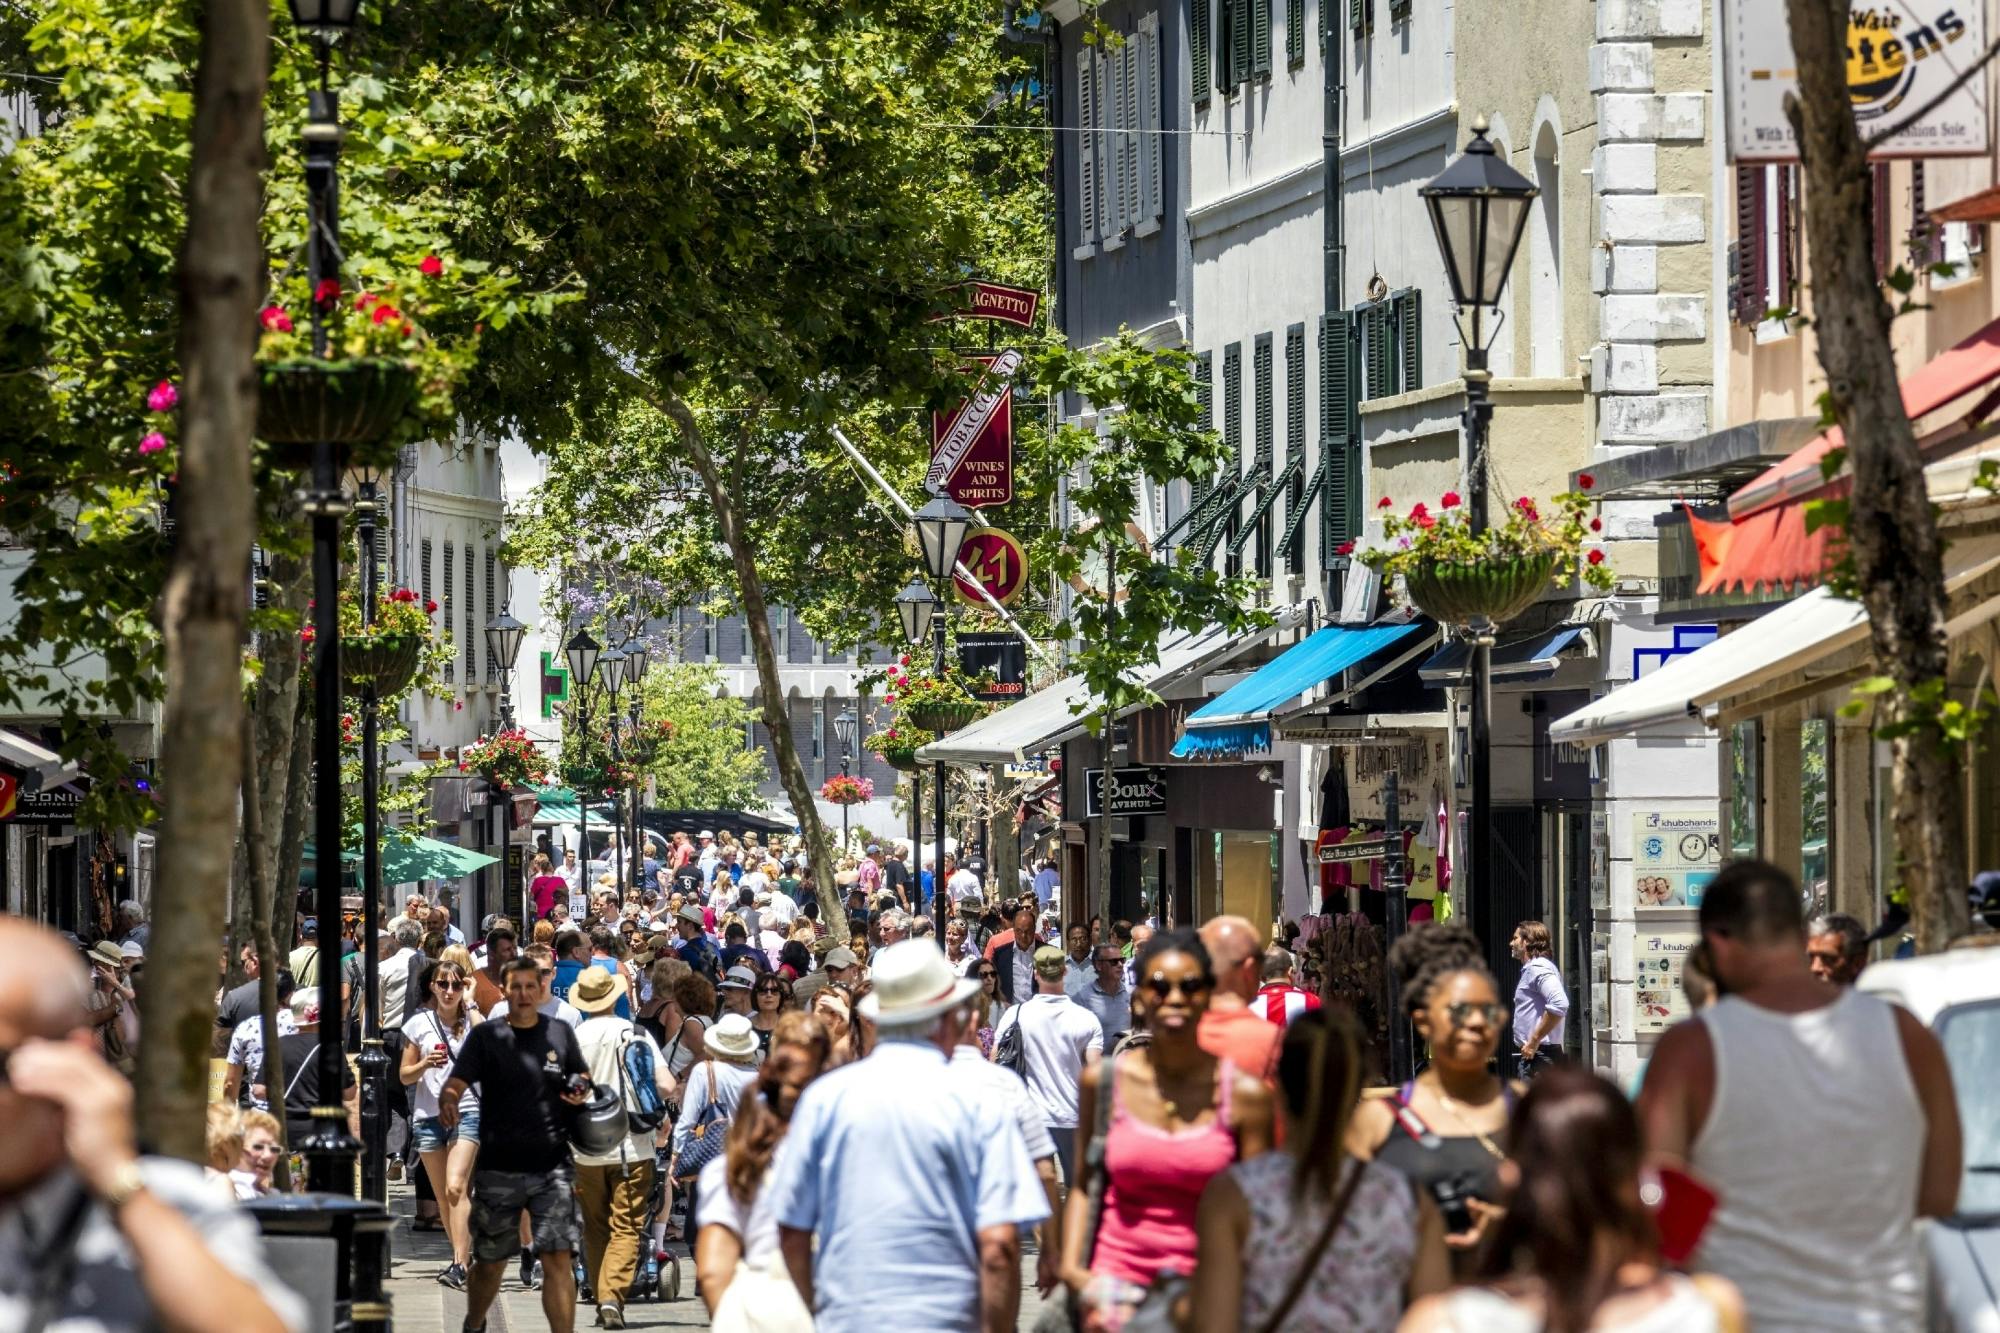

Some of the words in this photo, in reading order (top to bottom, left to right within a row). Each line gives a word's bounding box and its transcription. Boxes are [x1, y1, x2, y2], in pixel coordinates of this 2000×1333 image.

[1846, 8, 1966, 76] tens
[1756, 127, 1783, 142] With
[967, 291, 1029, 315] TAGNETTO
[942, 357, 1017, 461] TOBACCST
[965, 461, 1005, 472] WINES
[971, 475, 997, 485] AND
[958, 488, 1005, 499] SPIRITS
[962, 545, 1008, 591] 41
[986, 682, 1023, 694] banos
[1010, 760, 1044, 772] VISA
[1096, 776, 1165, 800] Boux
[1111, 800, 1151, 809] AVENUE
[1661, 819, 1717, 827] khubchands
[570, 905, 585, 913] £15
[1663, 943, 1695, 951] khubc
